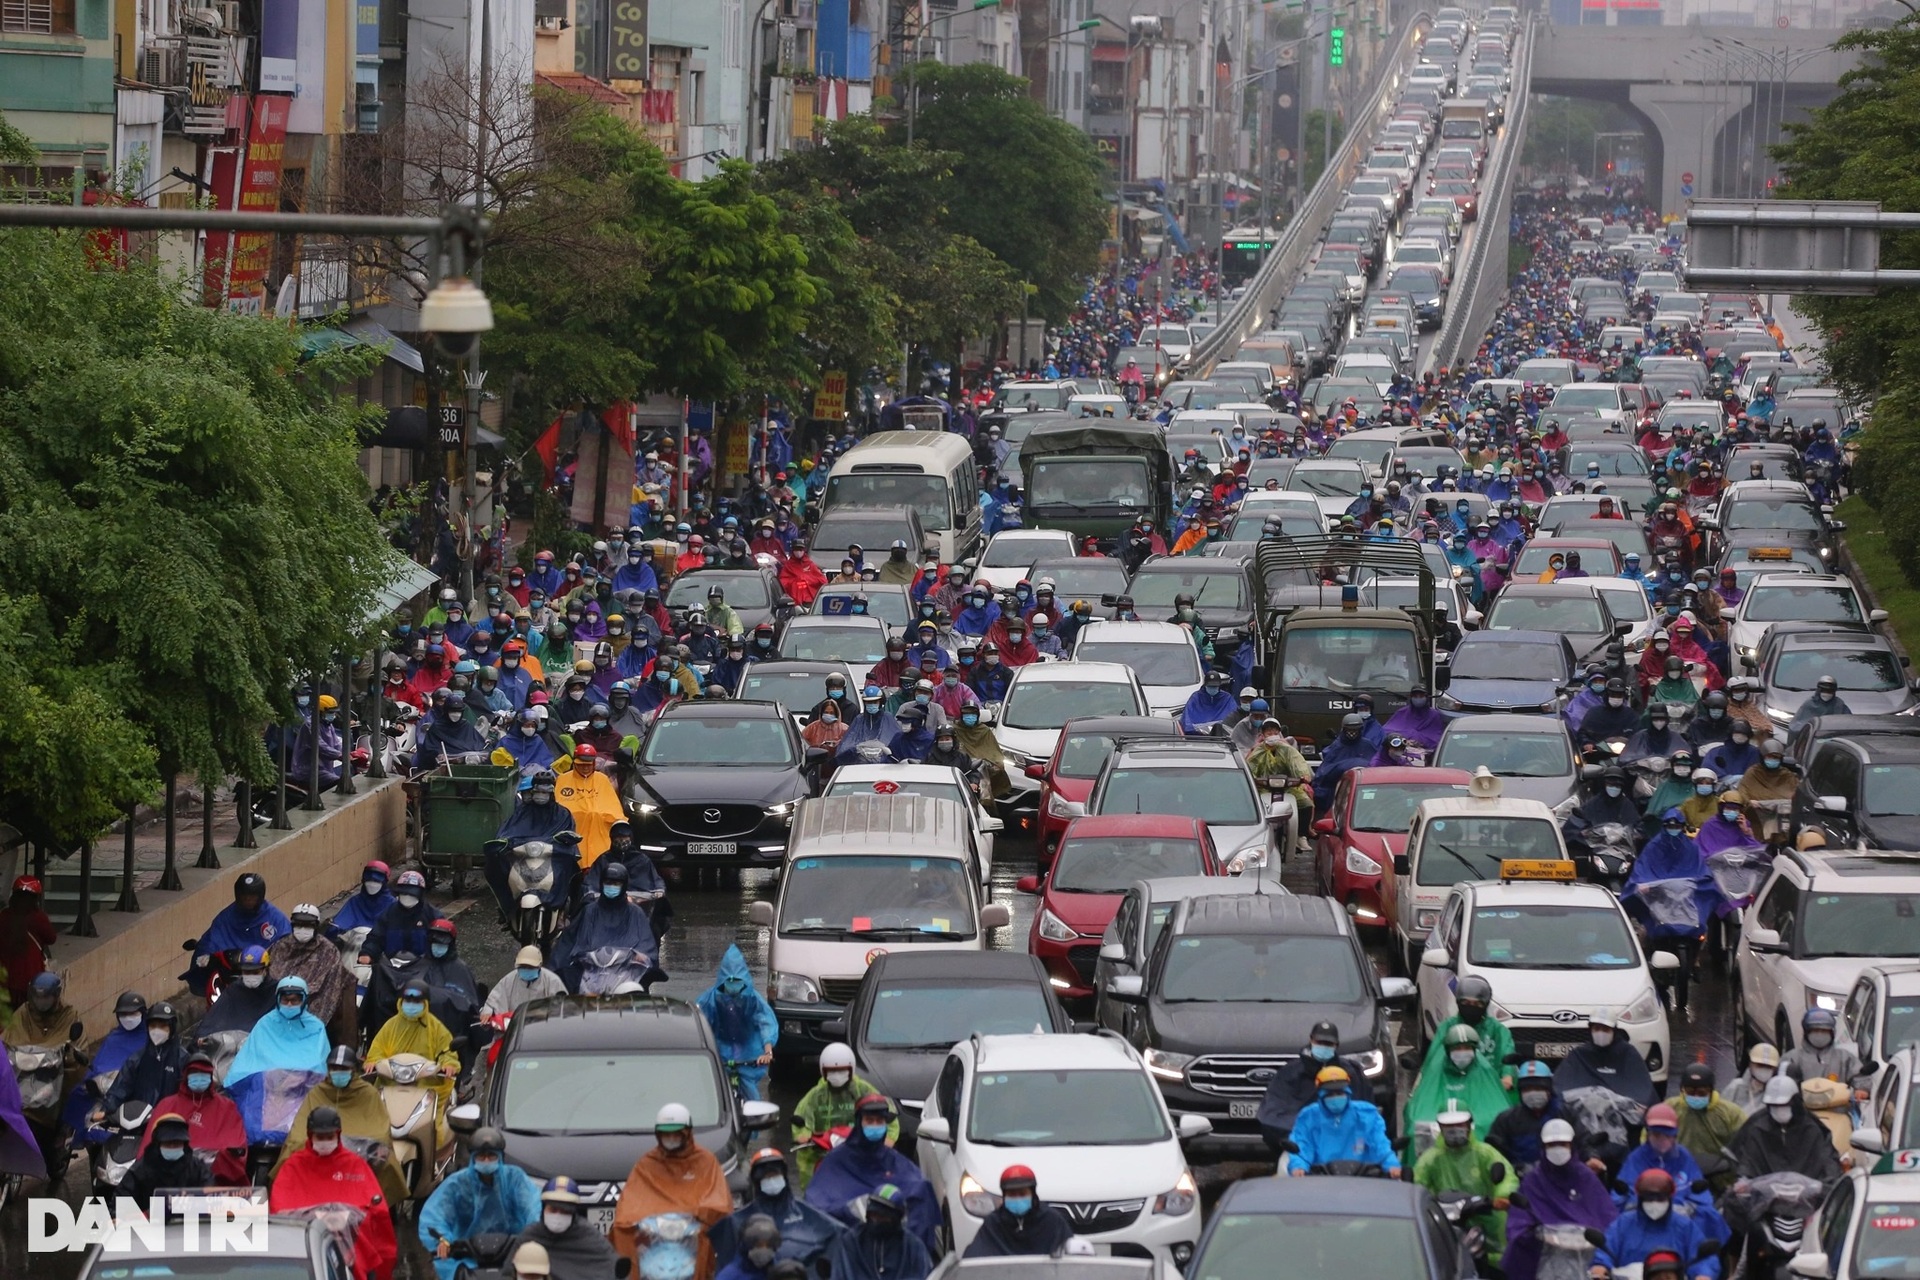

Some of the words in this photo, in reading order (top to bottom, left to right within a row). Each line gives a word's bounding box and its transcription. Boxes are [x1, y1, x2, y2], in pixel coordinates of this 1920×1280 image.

[439, 408, 457, 423] 36
[438, 428, 460, 443] 30A
[1328, 700, 1355, 710] ISU
[688, 843, 736, 853] 30F-350.19
